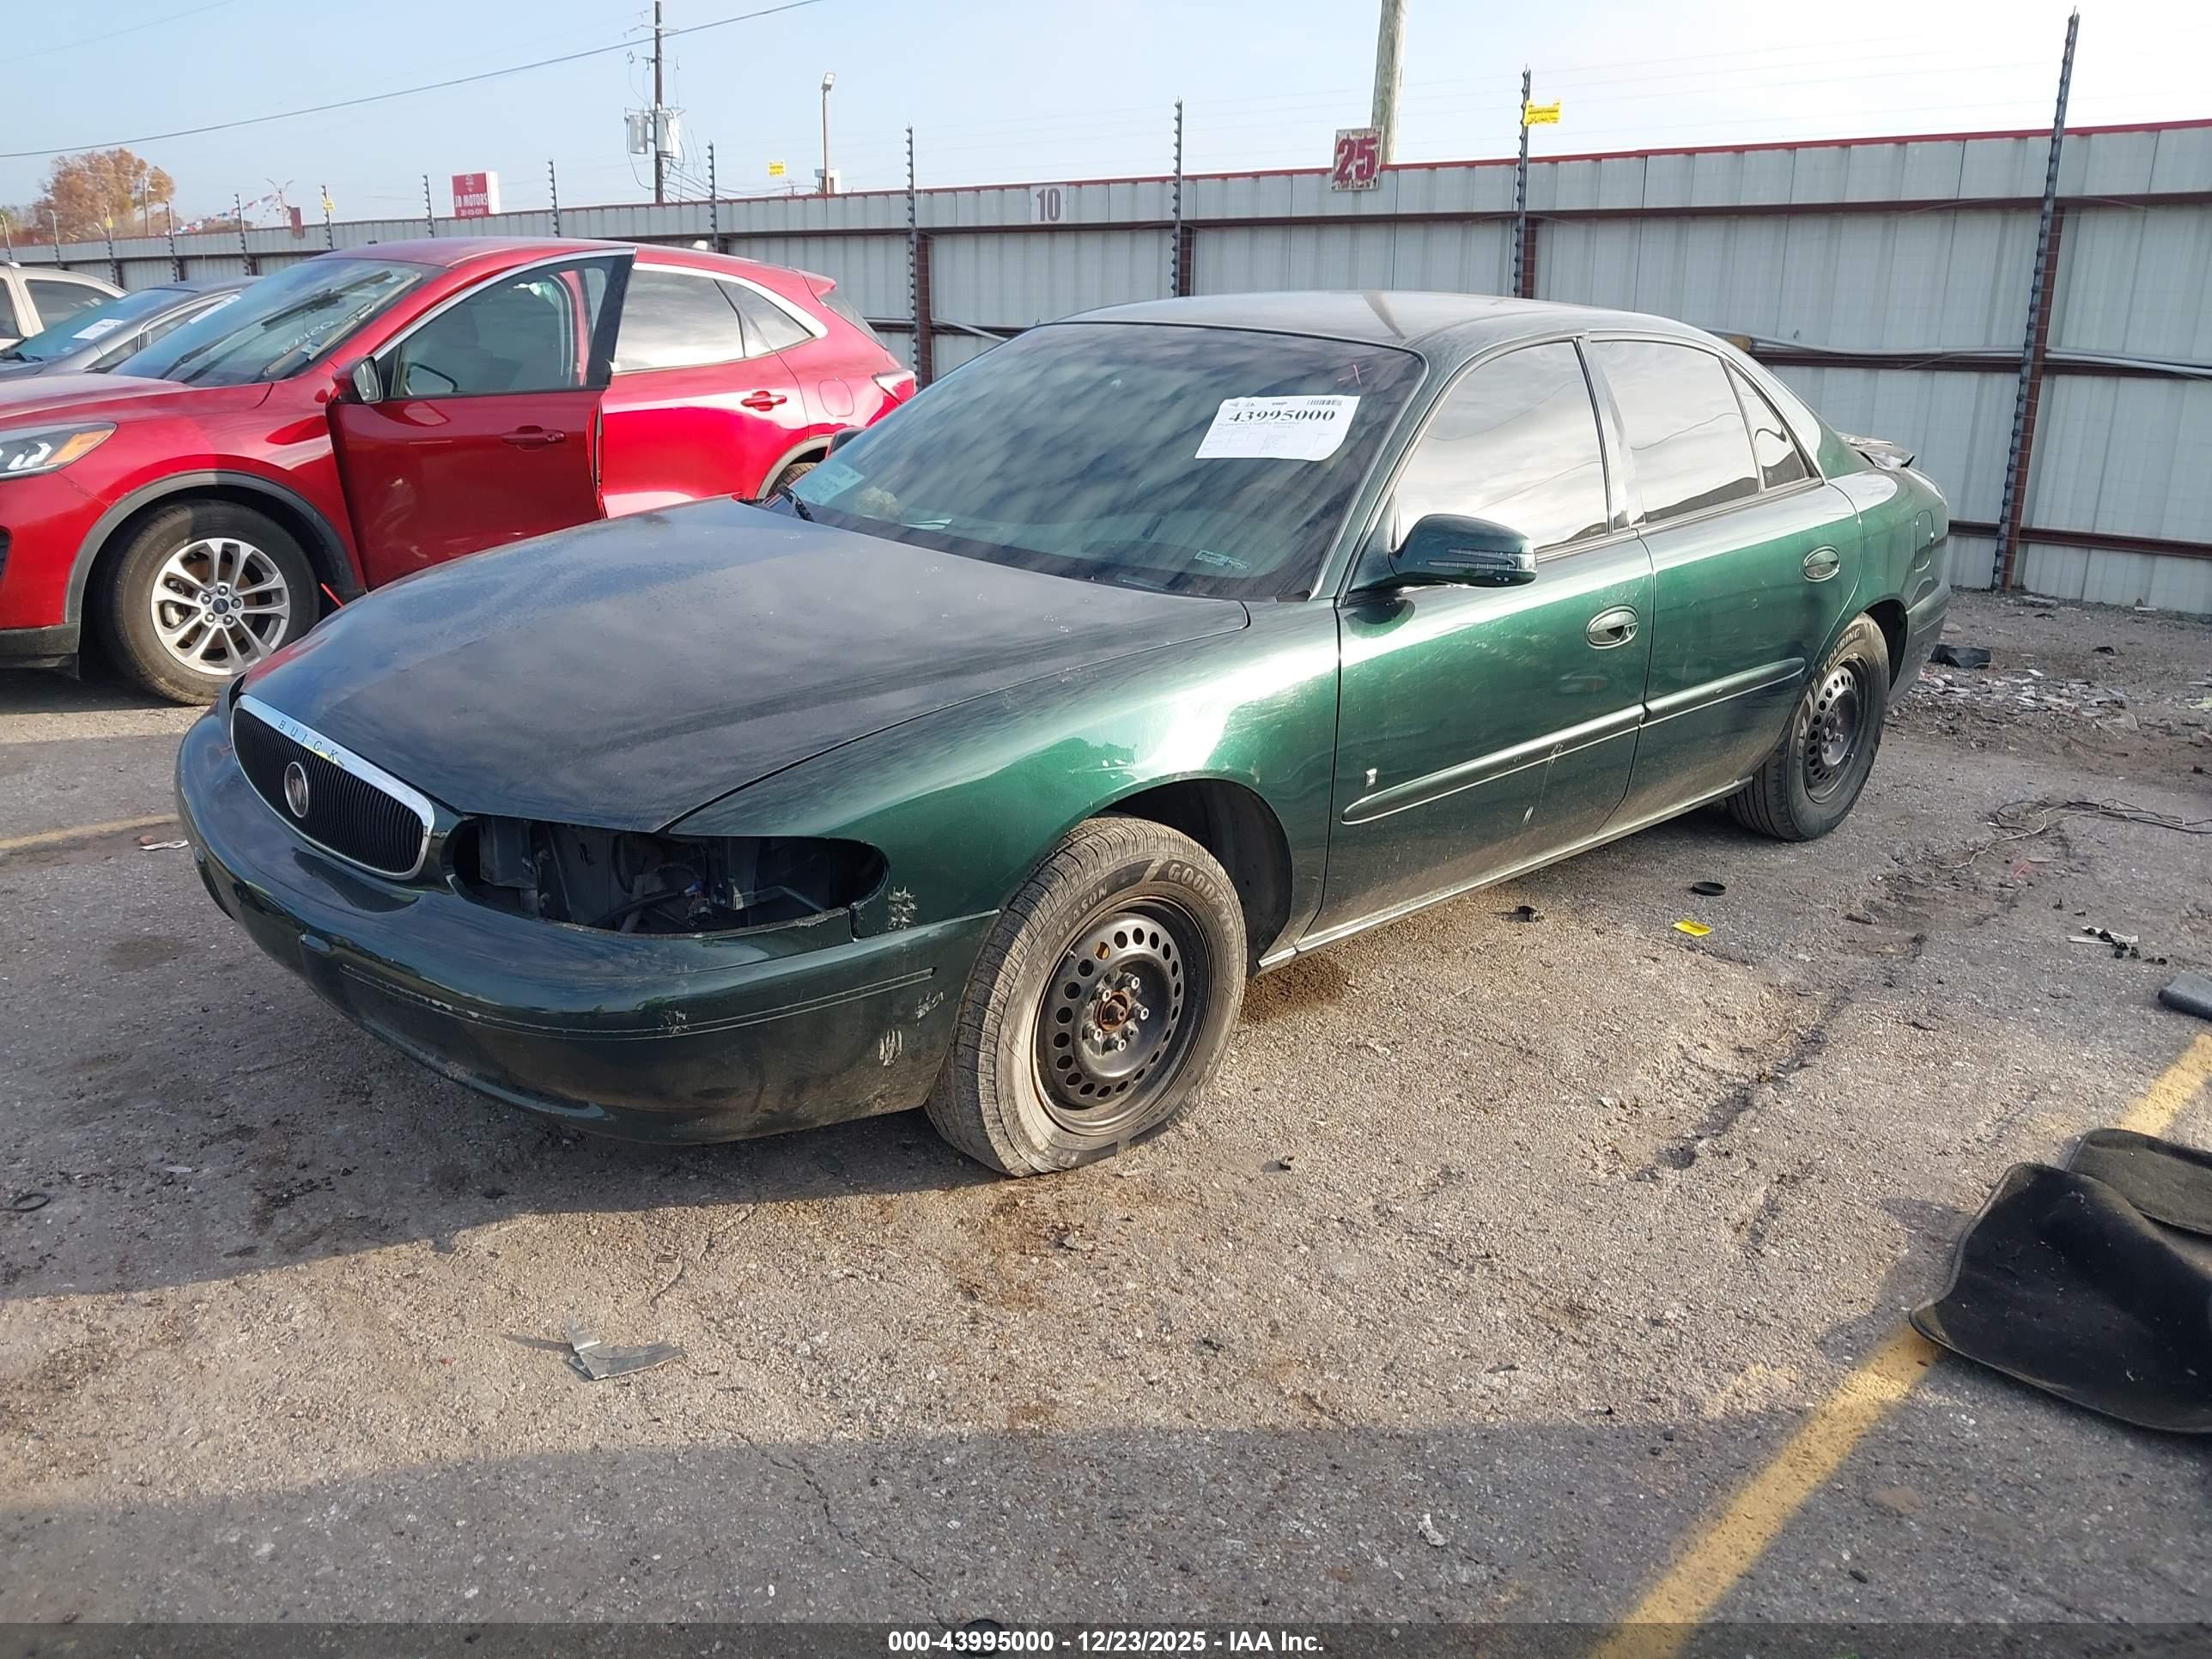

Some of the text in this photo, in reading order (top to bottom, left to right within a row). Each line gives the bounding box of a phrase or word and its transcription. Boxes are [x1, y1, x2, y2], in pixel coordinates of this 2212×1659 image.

[1335, 137, 1377, 180] 25
[463, 192, 488, 207] MOTORS
[1036, 187, 1061, 222] 10
[1229, 409, 1336, 422] 43995000
[1821, 628, 1861, 675] TOURING
[277, 720, 338, 763] BUICK
